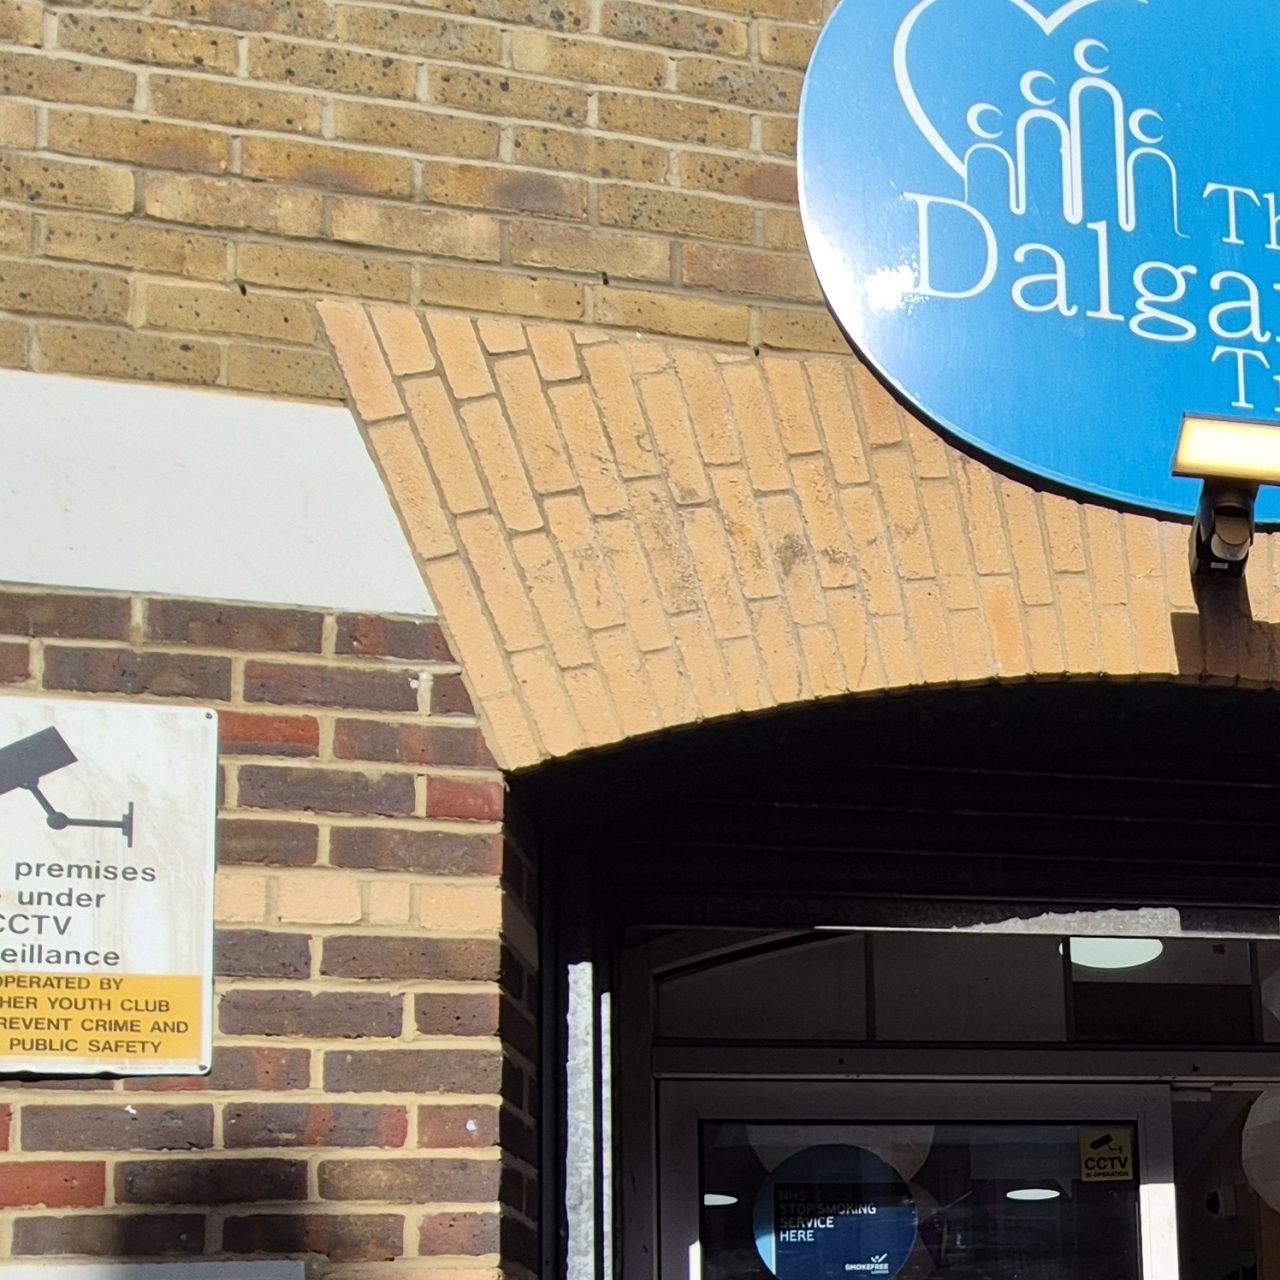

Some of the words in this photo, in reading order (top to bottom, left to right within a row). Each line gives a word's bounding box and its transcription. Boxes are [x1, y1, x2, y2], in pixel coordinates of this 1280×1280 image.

[15, 860, 157, 882] premises
[17, 888, 106, 908] under
[0, 914, 72, 936] CTV
[0, 975, 90, 990] PERATED
[100, 977, 124, 991] BY
[47, 996, 111, 1011] YOUTH
[120, 998, 170, 1013] CLUB
[81, 1018, 141, 1033] CRIME
[150, 1020, 189, 1034] AND
[9, 1037, 78, 1052] PUBLIC
[88, 1039, 162, 1054] SAFETY
[1084, 1156, 1128, 1170] CCTV
[778, 1189, 807, 1202] NHS
[778, 1203, 814, 1216] STOP
[815, 1202, 877, 1216] SMOKING
[779, 1216, 835, 1229] SERVICE
[779, 1229, 815, 1243] HERE
[844, 1263, 889, 1271] SMOKEFREE
